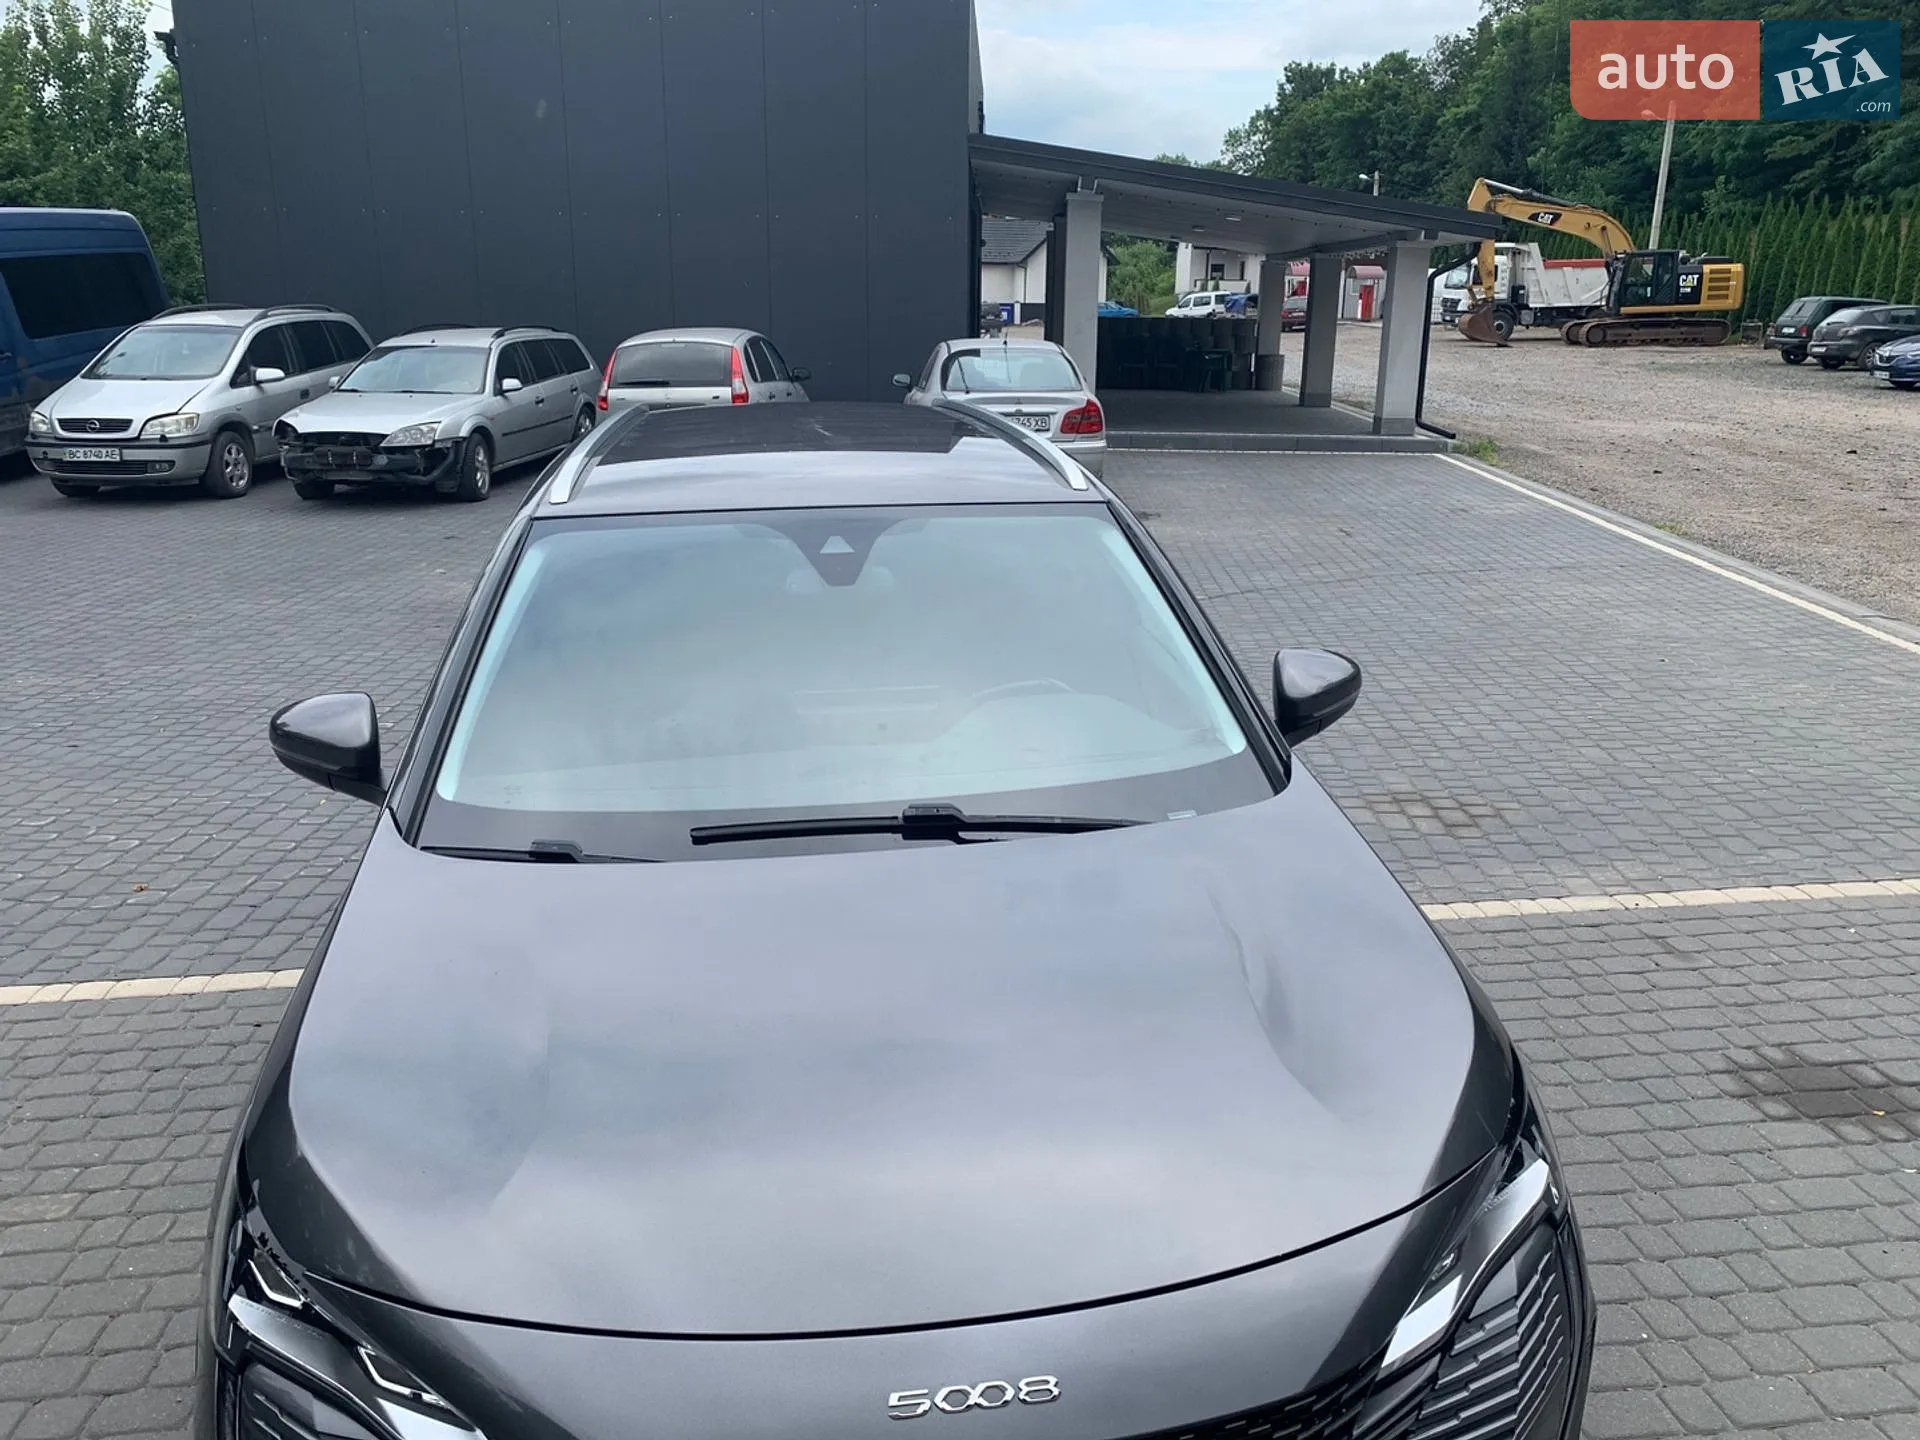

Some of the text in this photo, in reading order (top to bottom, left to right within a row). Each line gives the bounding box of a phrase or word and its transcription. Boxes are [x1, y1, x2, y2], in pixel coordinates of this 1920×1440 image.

[1538, 212, 1554, 224] CAT
[1679, 274, 1699, 287] CAT
[104, 449, 118, 460] AE
[888, 1375, 1061, 1420] 5008
